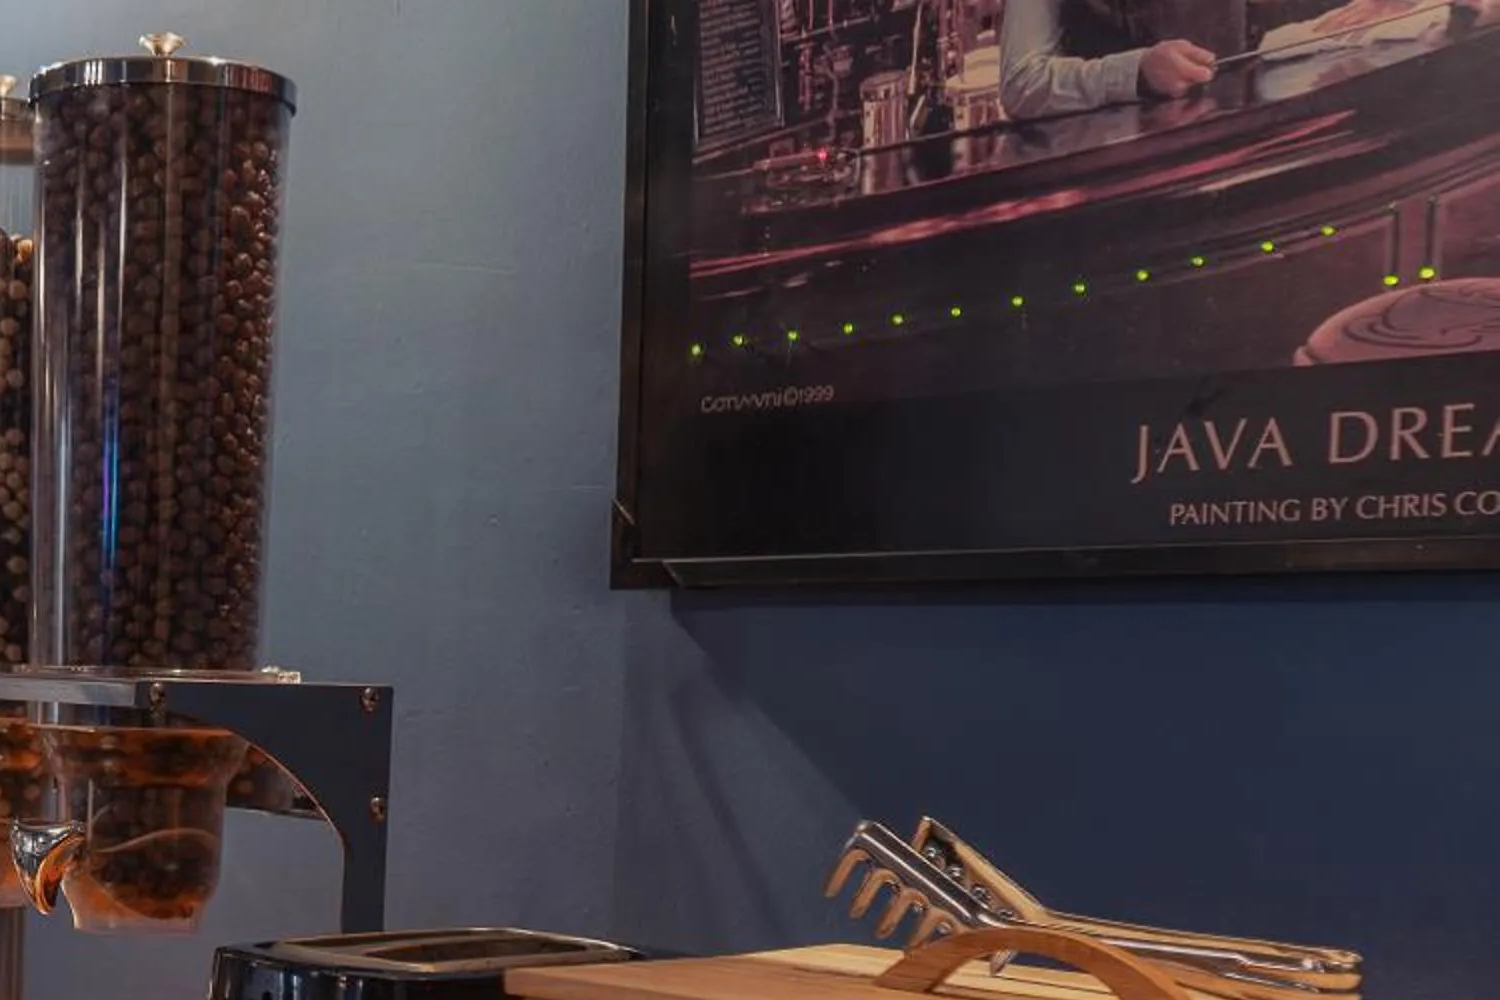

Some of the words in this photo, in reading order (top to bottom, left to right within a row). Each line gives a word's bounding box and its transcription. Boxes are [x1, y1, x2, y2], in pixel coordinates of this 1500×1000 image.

[1130, 417, 1294, 484] JAVA
[1169, 499, 1300, 526] PAINTING
[1311, 497, 1349, 521] BY
[1355, 492, 1448, 520] CHRIS
[1453, 490, 1500, 516] CO
